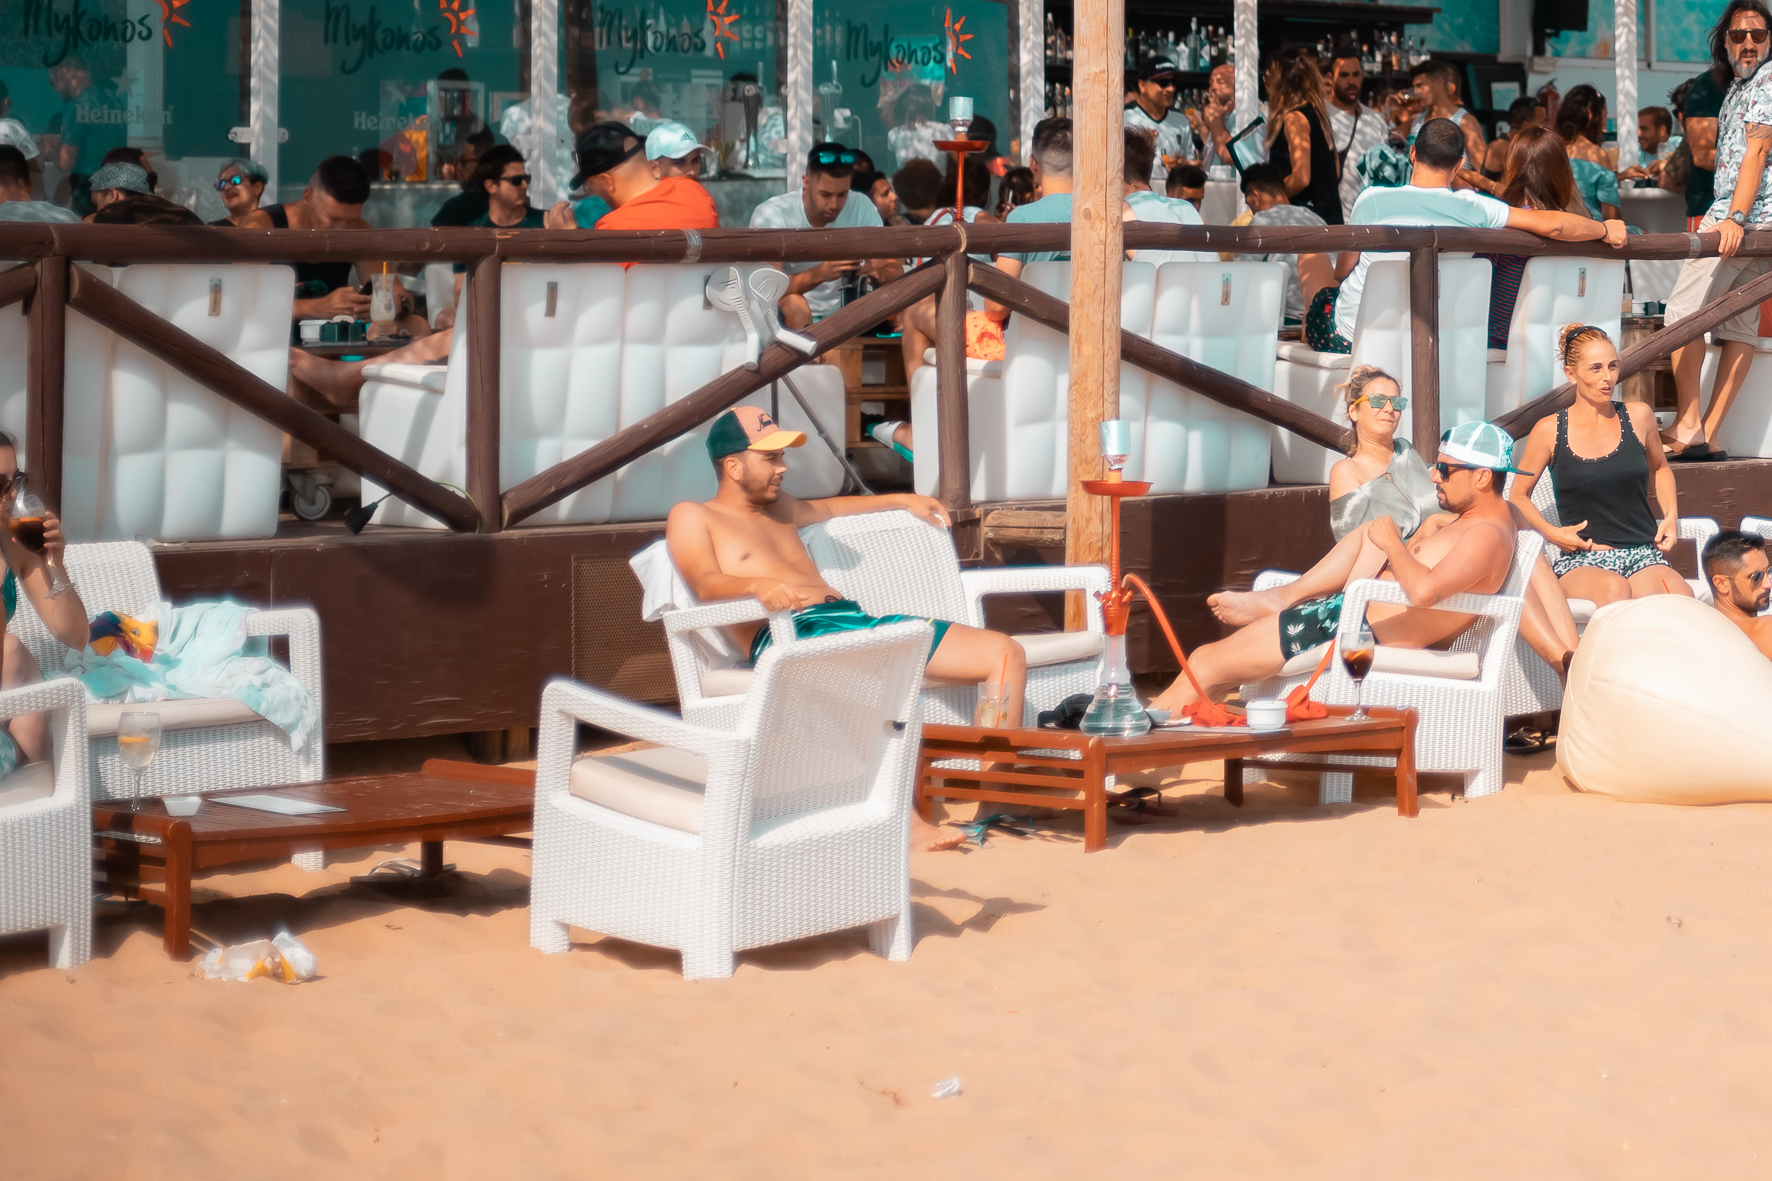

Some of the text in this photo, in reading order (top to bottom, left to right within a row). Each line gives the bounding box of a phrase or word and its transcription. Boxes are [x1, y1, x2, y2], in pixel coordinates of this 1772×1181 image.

[323, 0, 443, 75] Mykonos
[598, 3, 707, 75] Mykonos
[845, 19, 946, 88] Mykonos
